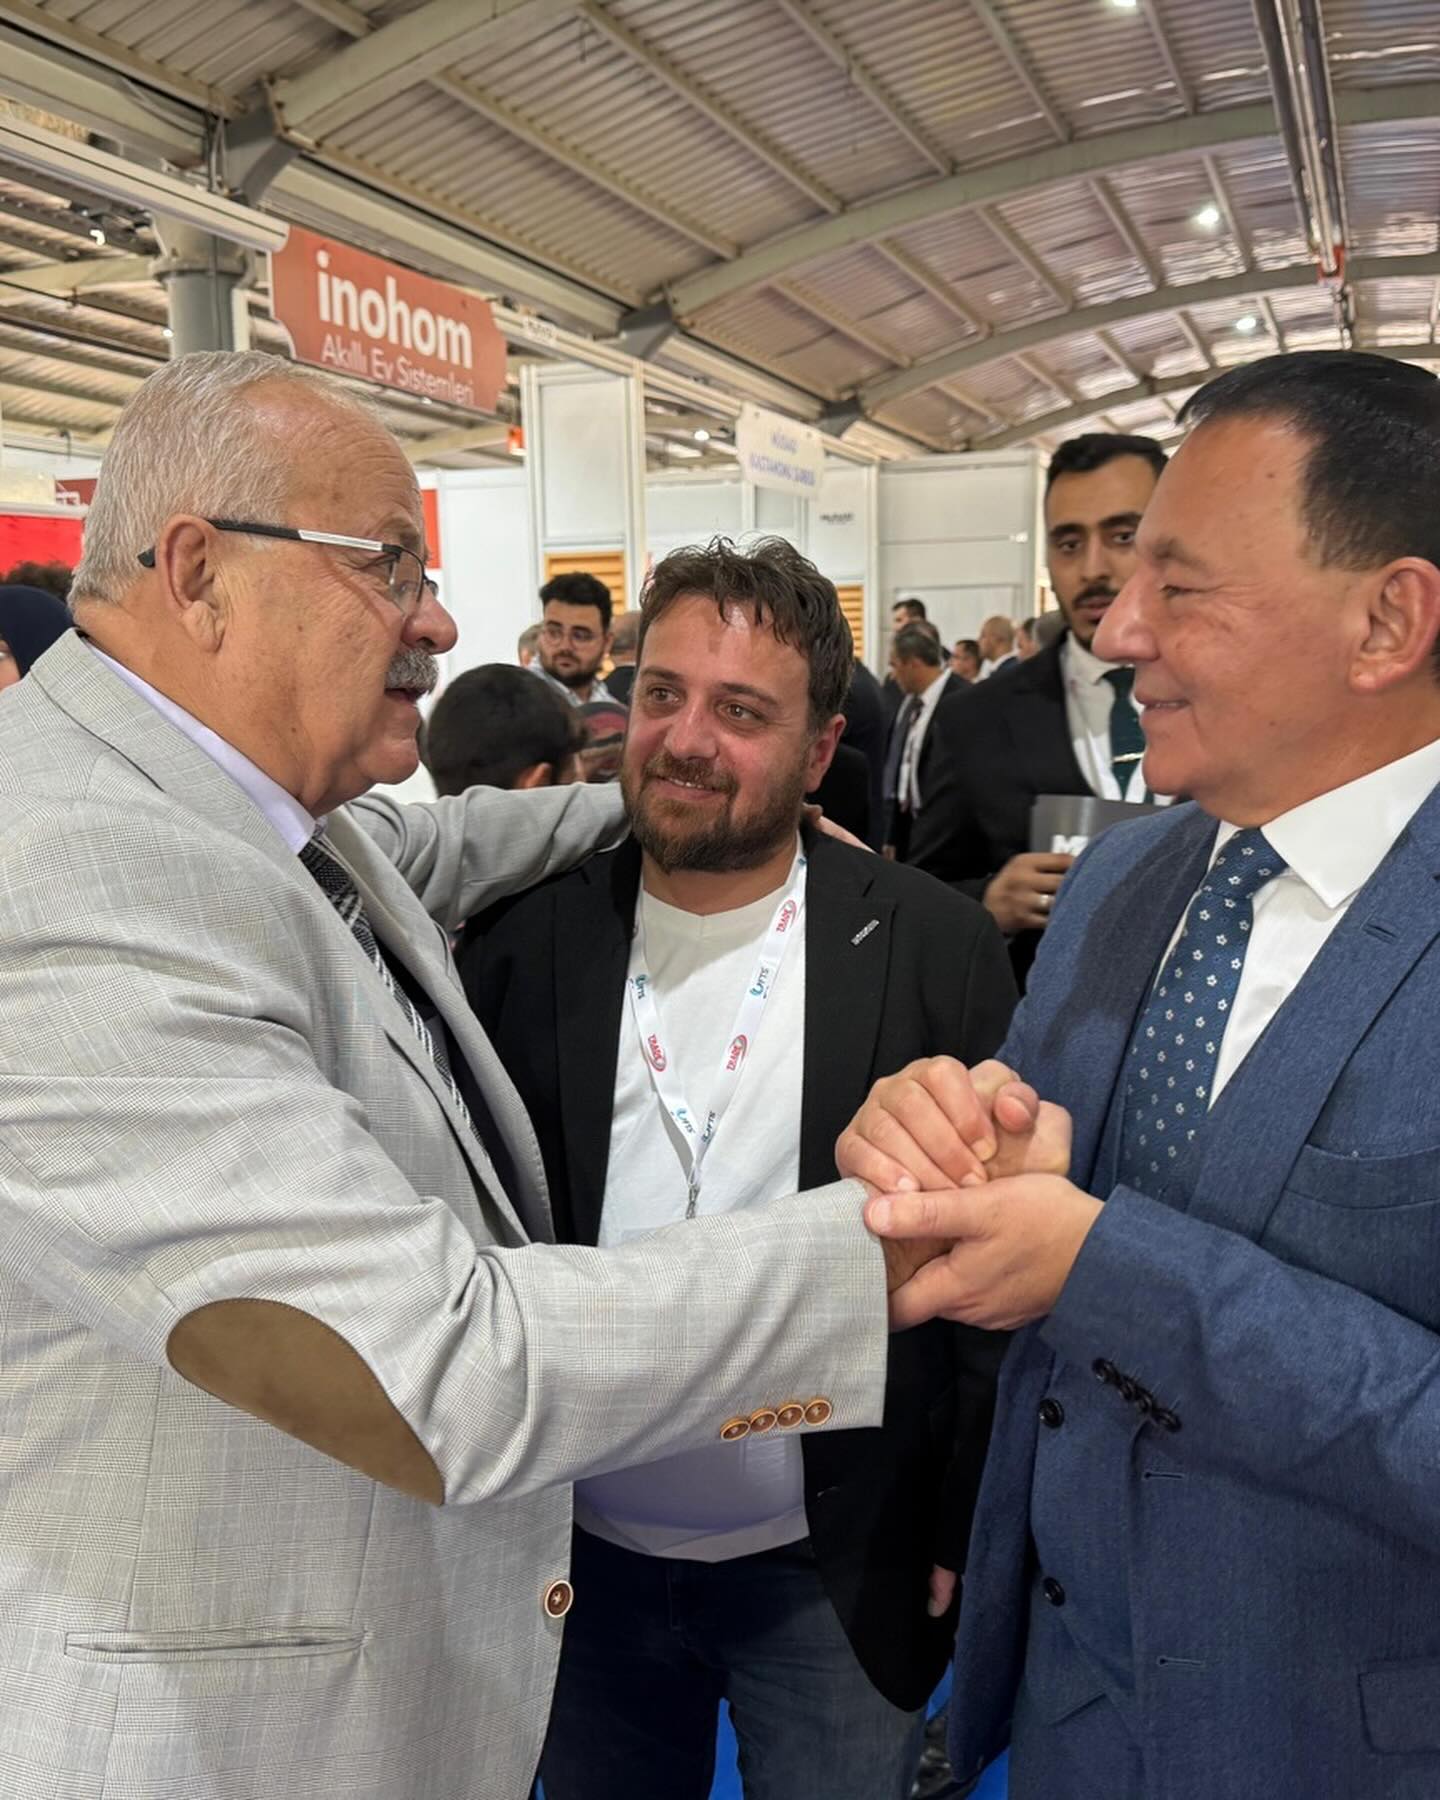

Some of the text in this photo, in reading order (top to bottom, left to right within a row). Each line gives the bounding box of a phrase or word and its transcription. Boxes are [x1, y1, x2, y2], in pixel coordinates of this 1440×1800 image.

[316, 249, 473, 370] inohom
[320, 333, 475, 405] Akıllı Ev Sistemleri
